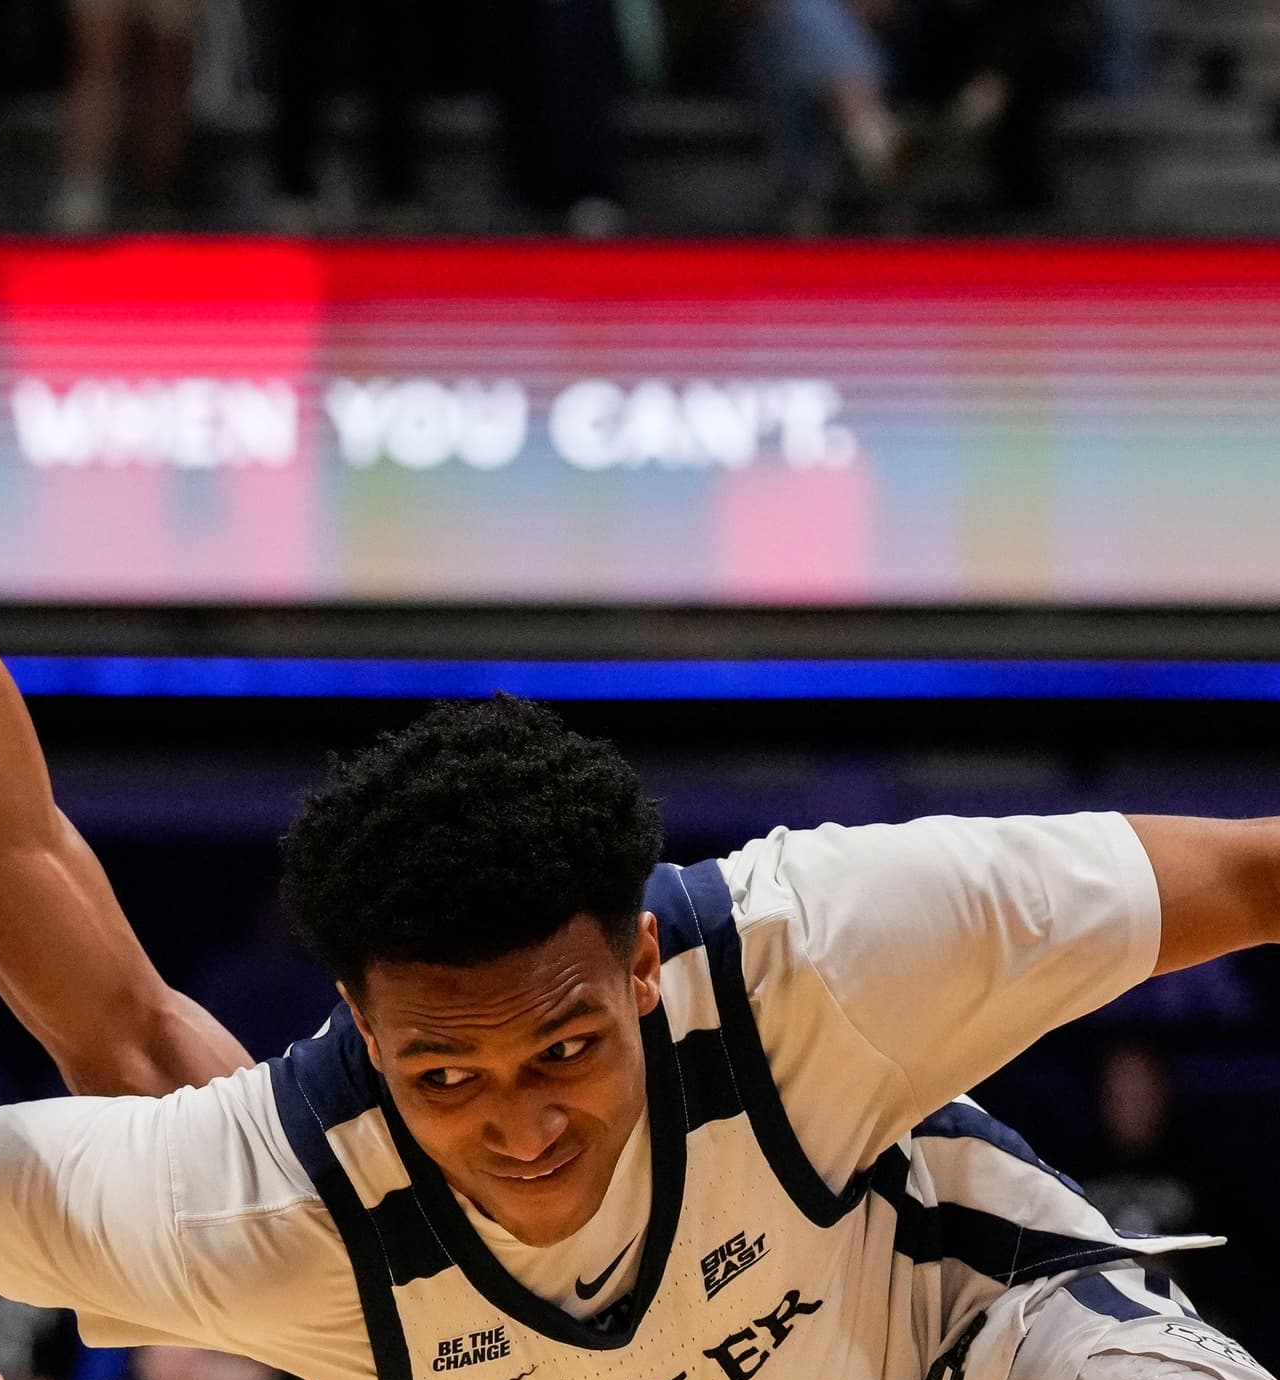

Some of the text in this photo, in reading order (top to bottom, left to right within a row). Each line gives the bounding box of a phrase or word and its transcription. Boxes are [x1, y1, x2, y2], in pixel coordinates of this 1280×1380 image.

[15, 379, 298, 468] WHEN
[326, 379, 526, 468] YOU
[700, 1230, 746, 1277] BIG
[703, 1232, 766, 1293] EAST
[432, 1339, 511, 1373] CHANGE
[438, 1325, 505, 1357] BE THE
